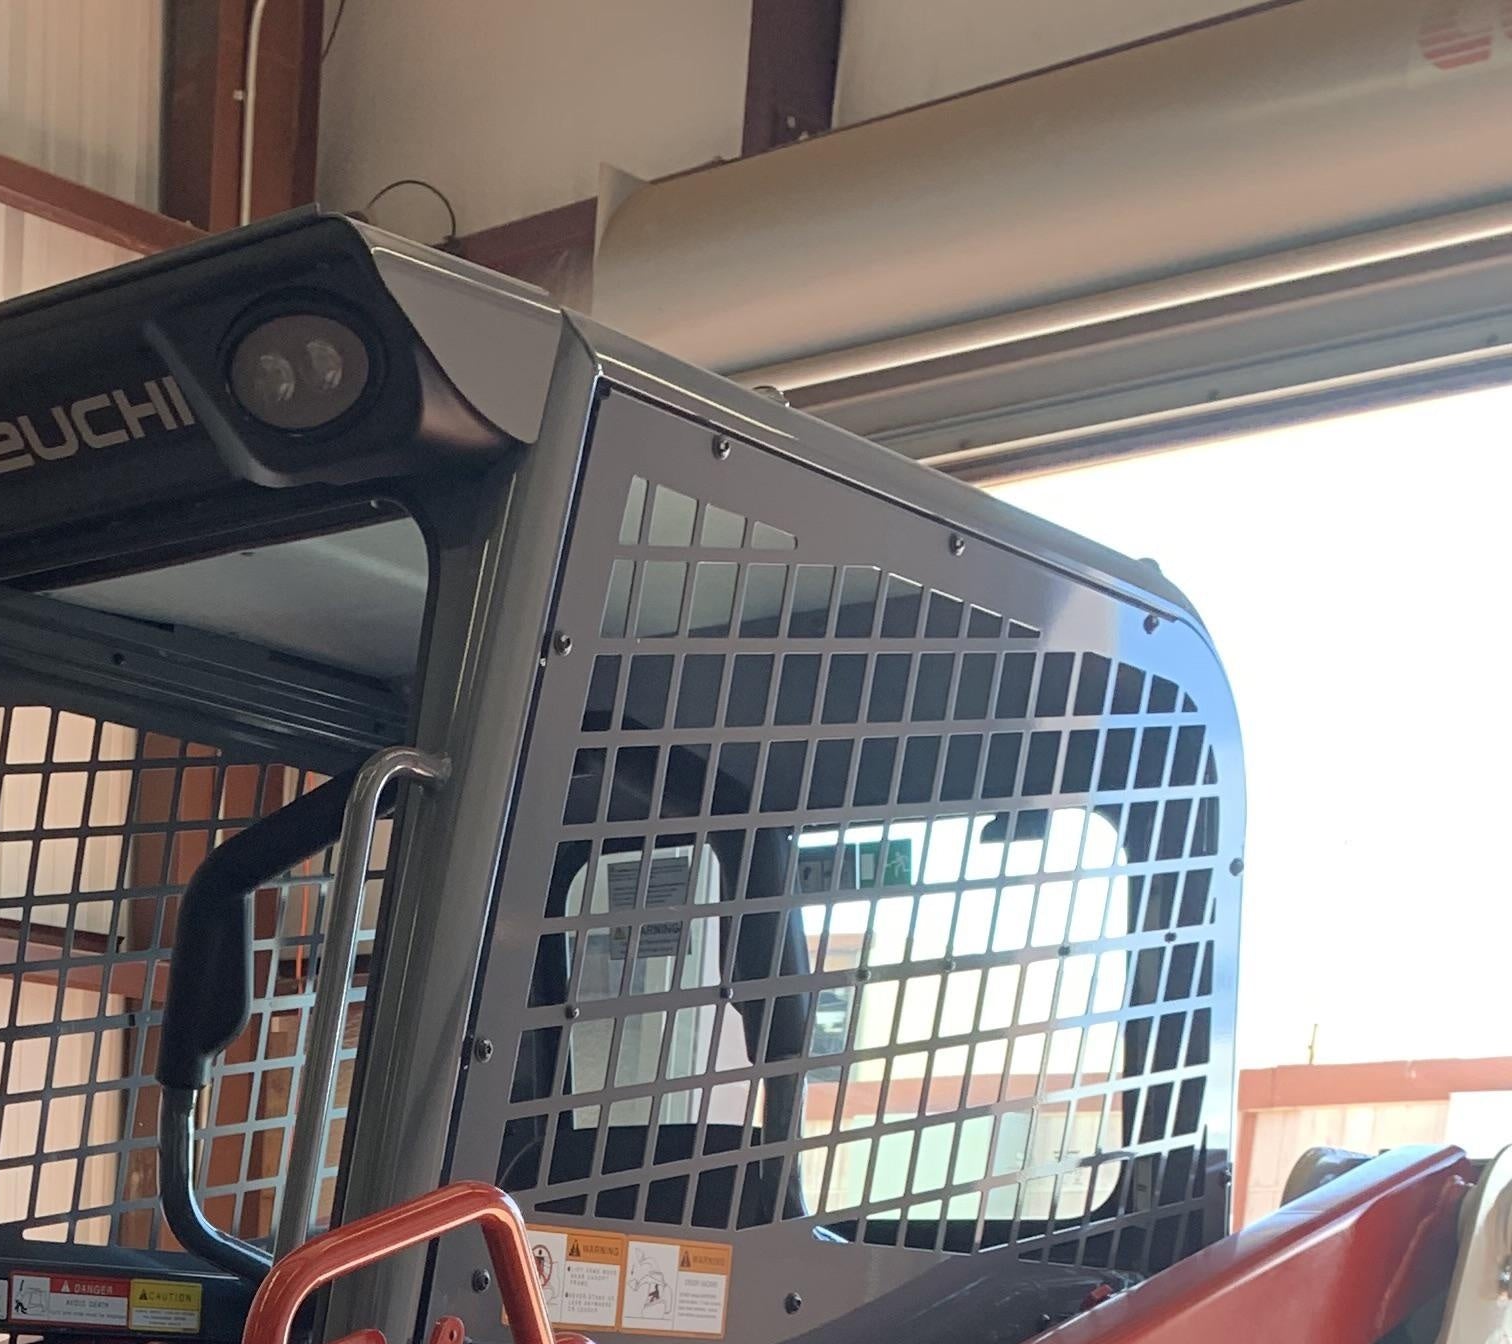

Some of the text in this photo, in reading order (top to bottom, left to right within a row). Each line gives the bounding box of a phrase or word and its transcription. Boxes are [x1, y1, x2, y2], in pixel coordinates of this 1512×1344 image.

[582, 1244, 619, 1256] WARNING
[74, 1283, 113, 1295] DANGER
[148, 1291, 192, 1303] CAUTION
